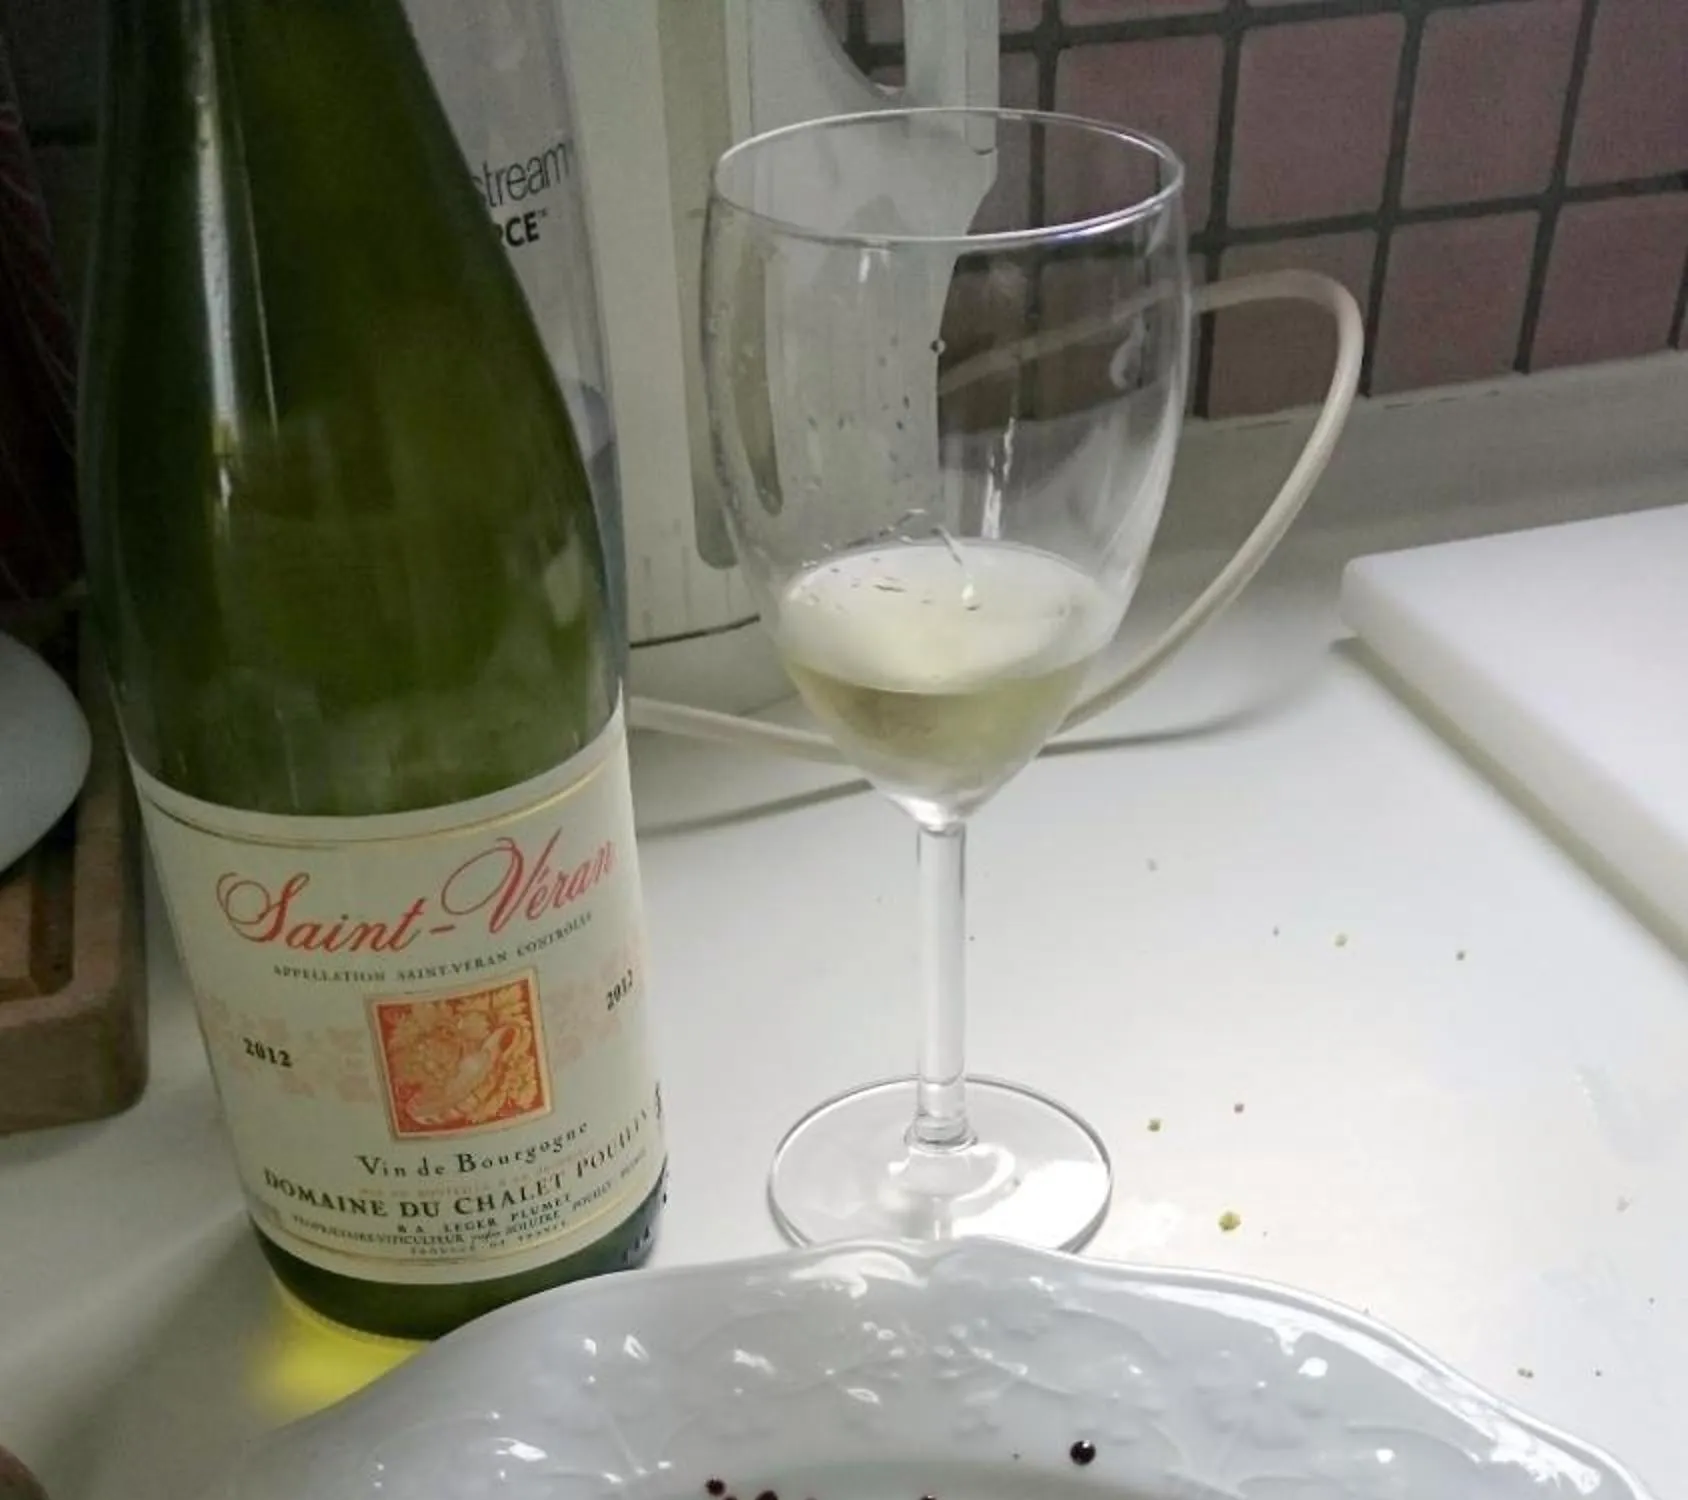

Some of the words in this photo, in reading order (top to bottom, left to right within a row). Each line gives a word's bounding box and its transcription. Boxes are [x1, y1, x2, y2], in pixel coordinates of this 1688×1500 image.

[273, 964, 386, 982] APPELLATION
[606, 968, 634, 1012] 2012
[242, 1036, 294, 1068] 2012
[355, 1154, 407, 1178] Vin
[416, 1156, 446, 1177] de
[457, 1122, 588, 1173] Bourgogne
[263, 1166, 389, 1218] DOMAINE
[400, 1201, 441, 1218] DU
[453, 1172, 565, 1215] CHALET
